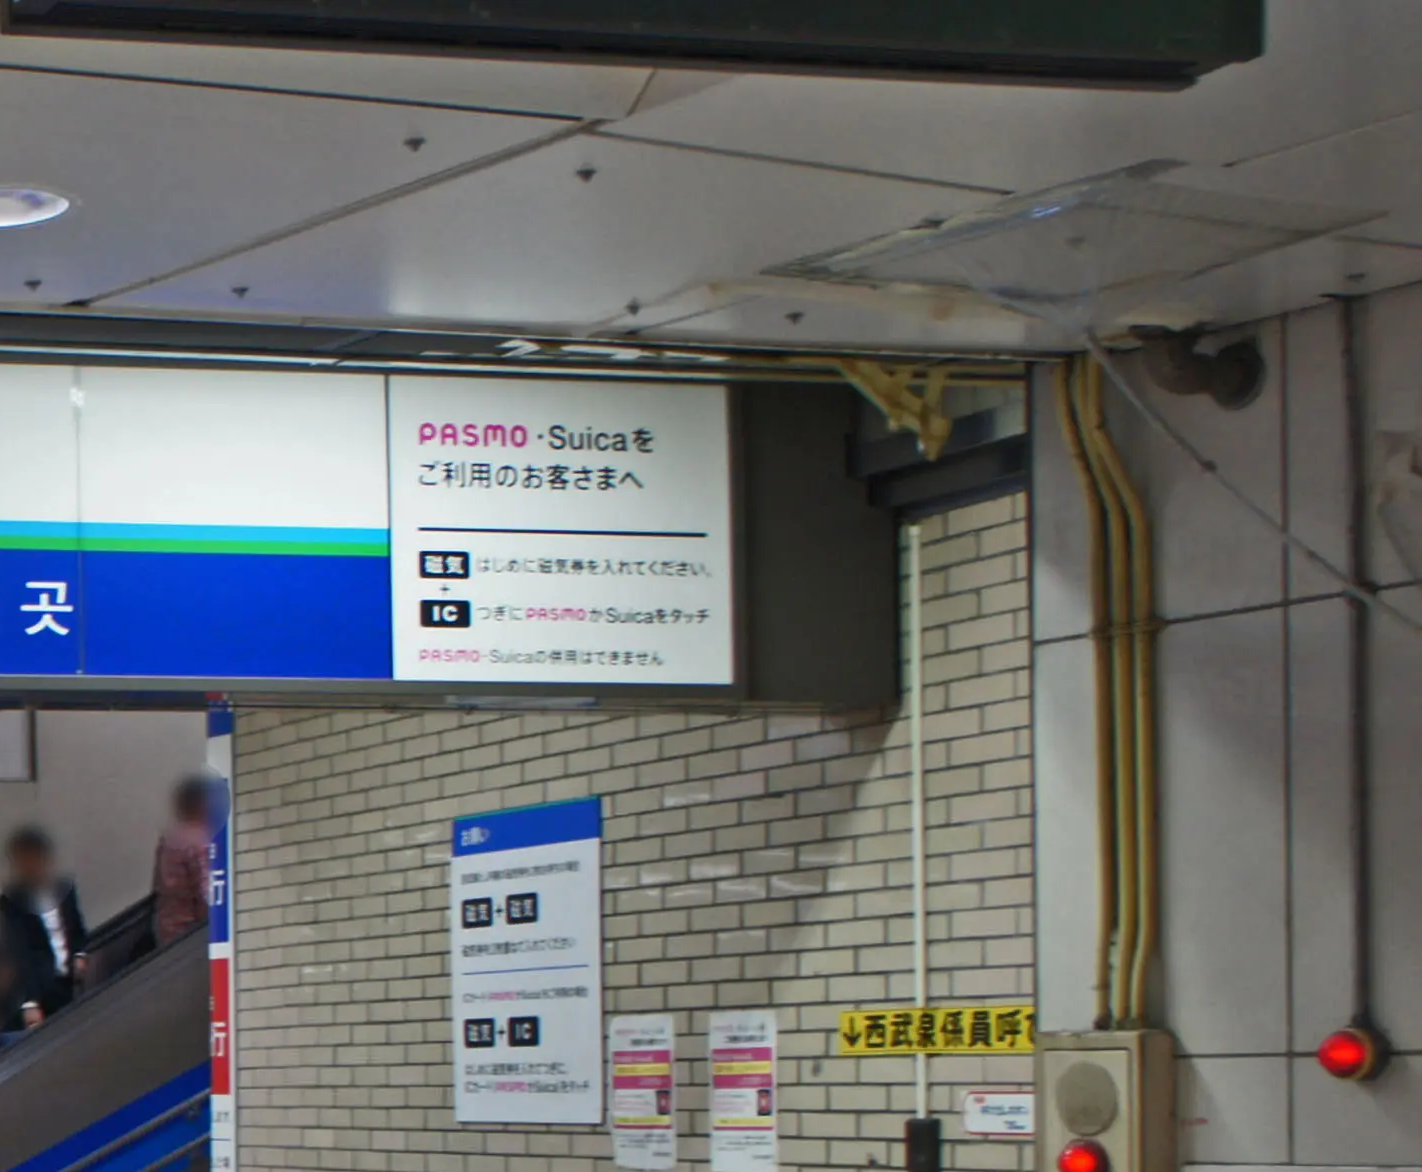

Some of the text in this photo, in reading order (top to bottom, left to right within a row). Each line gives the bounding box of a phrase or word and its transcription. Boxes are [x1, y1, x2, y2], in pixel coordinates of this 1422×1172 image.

[418, 461, 645, 491] ご利用のお客さまへ
[20, 581, 75, 637] 곳
[431, 605, 459, 622] IC
